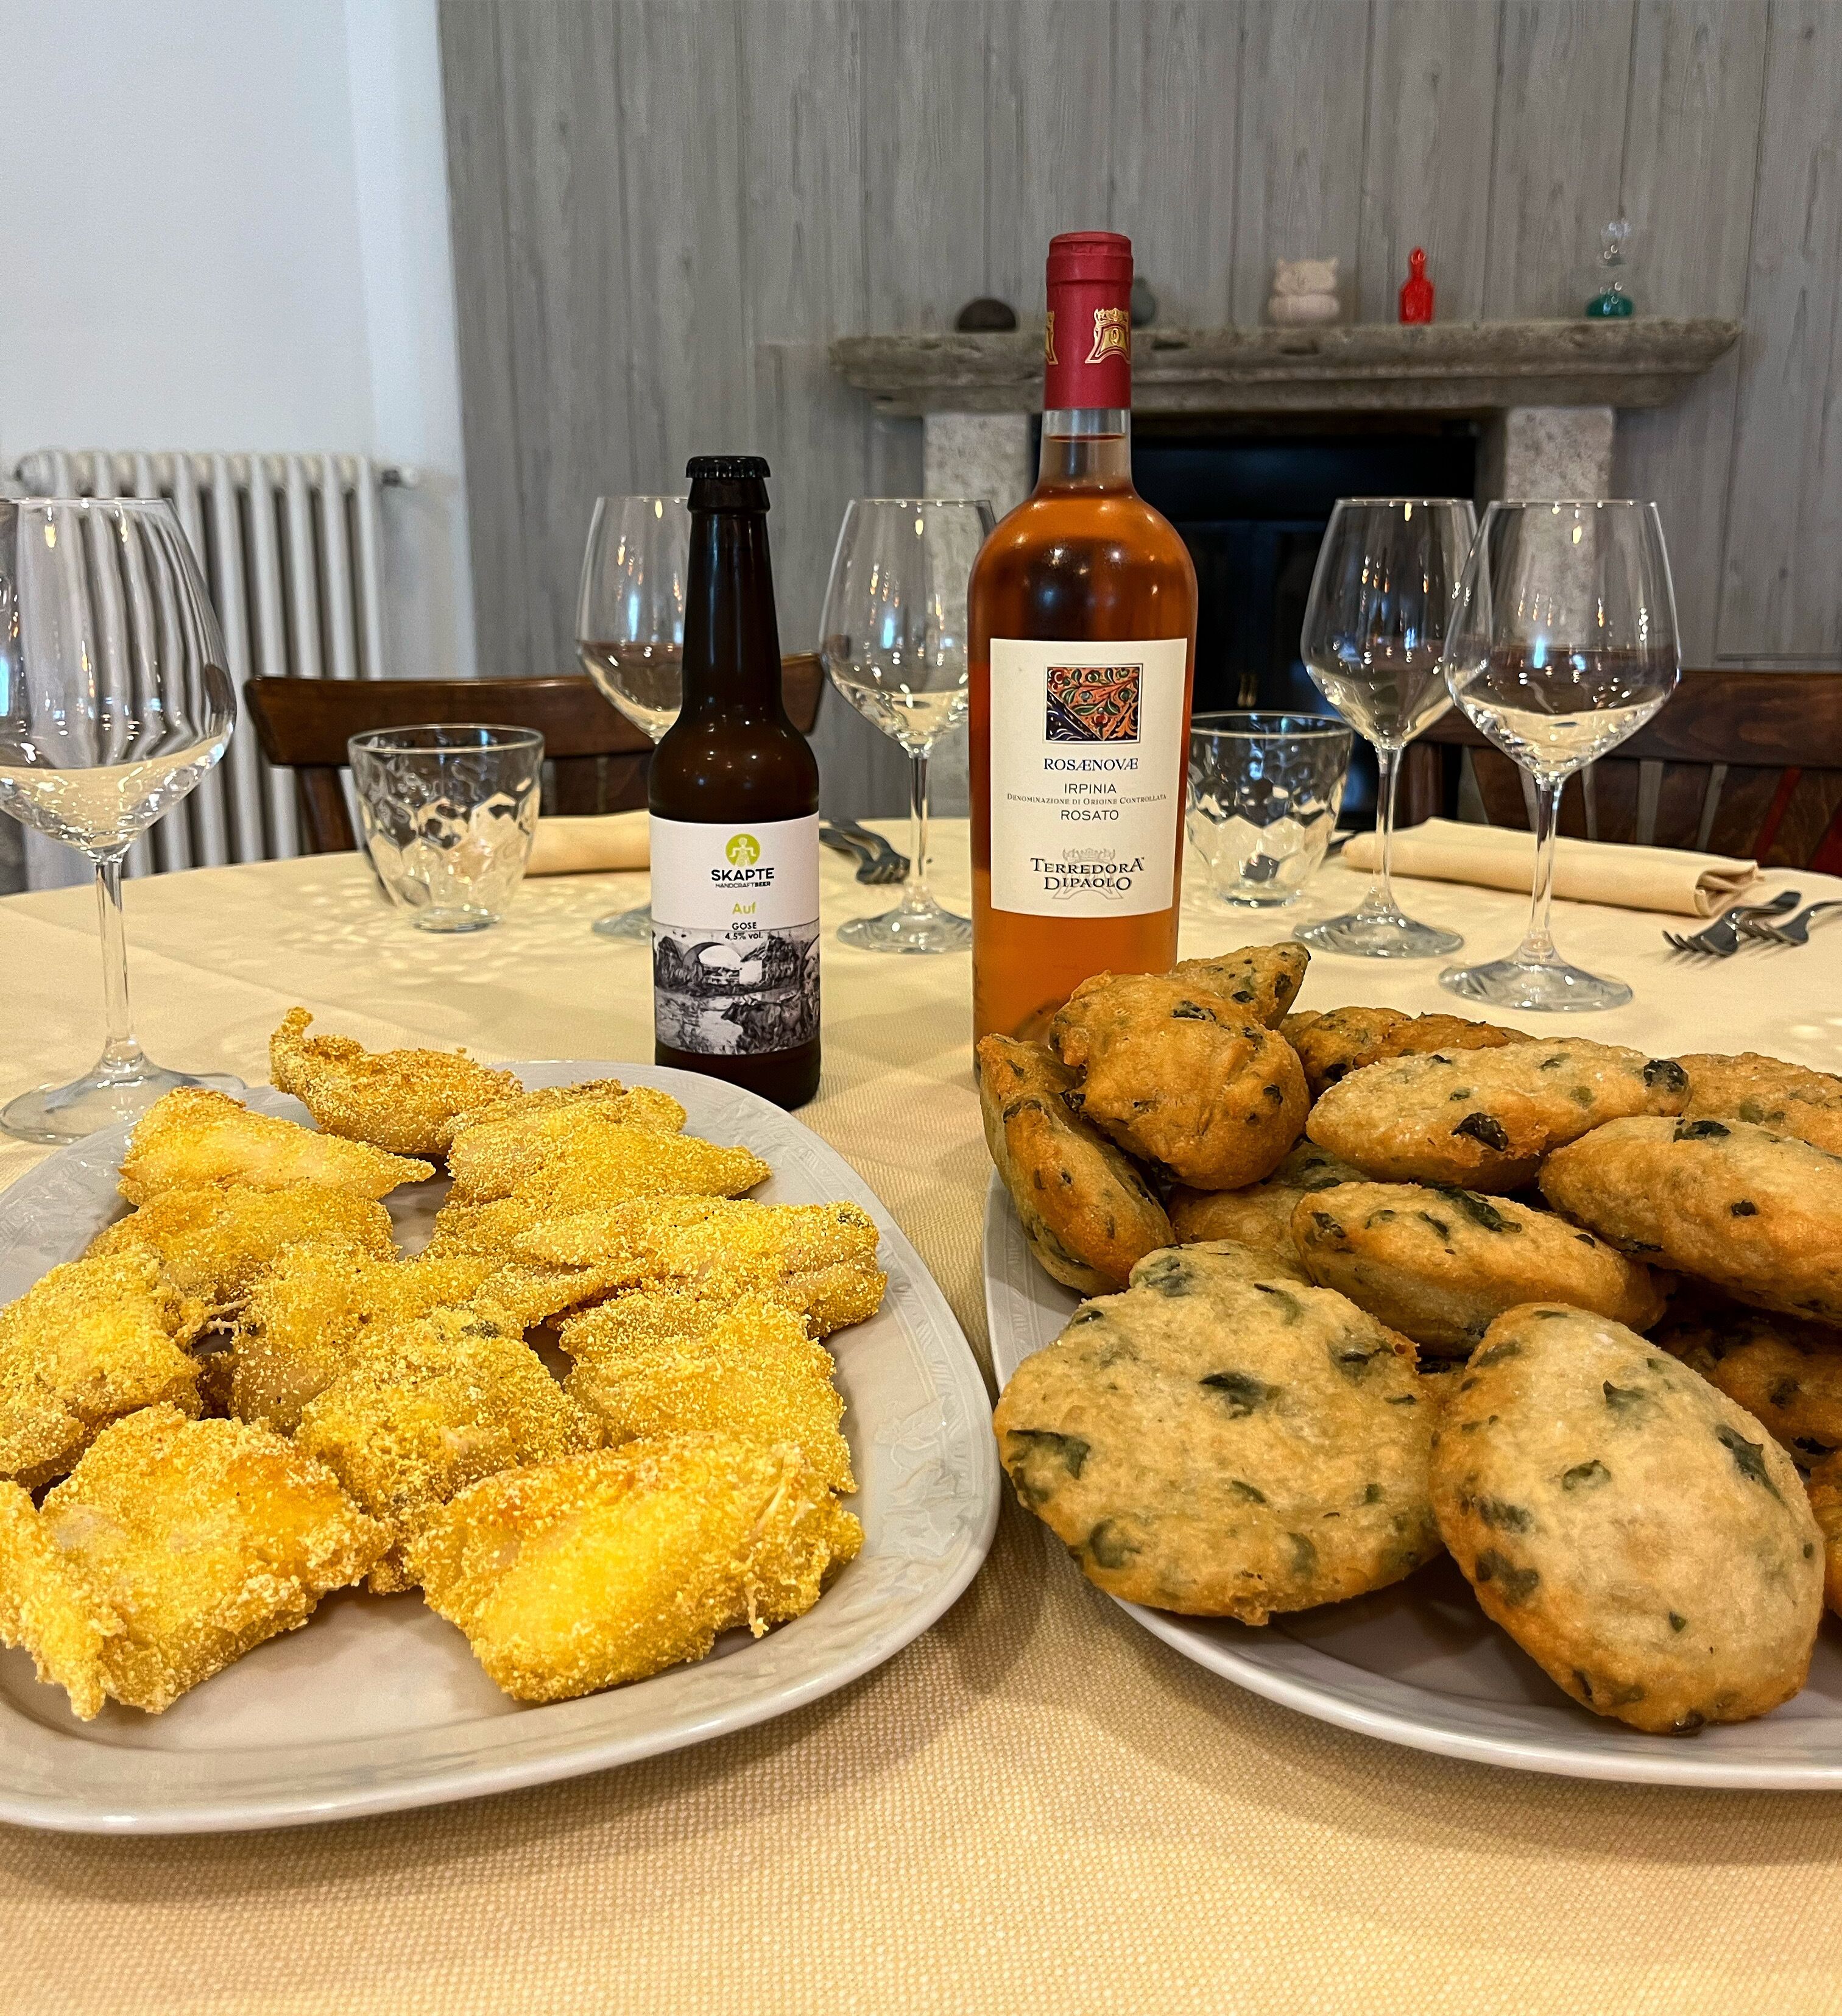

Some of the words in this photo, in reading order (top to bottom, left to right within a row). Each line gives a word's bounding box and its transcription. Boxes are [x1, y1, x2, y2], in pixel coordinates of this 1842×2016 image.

[1064, 783, 1117, 794] IRPINIA
[1060, 810, 1119, 821] ROSATO
[1030, 857, 1145, 874] TERREDORA
[711, 867, 775, 881] SKAPTE
[1043, 877, 1132, 891] DIPAOLO
[732, 902, 756, 914] Auf
[732, 921, 757, 930] GOSE
